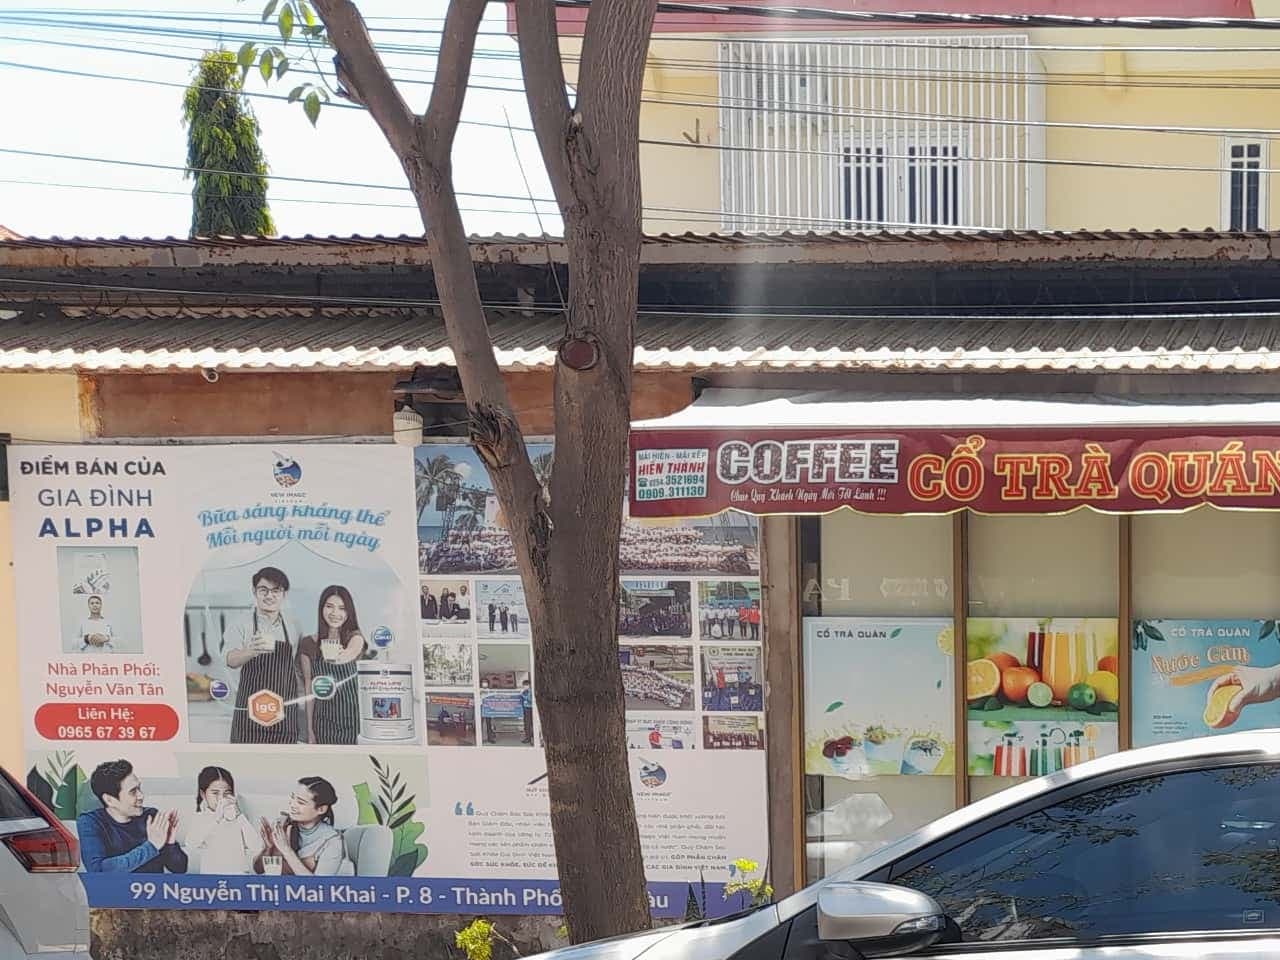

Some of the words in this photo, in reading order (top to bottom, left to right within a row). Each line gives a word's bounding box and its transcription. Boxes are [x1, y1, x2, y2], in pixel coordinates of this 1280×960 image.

[20, 455, 69, 475] ĐIỂM
[76, 457, 118, 475] BÁN
[124, 456, 166, 475] CỦA
[716, 439, 899, 485] COFFEE
[907, 434, 985, 501] CỔ
[994, 443, 1119, 500] TRÀ
[38, 489, 82, 507] GIA
[90, 484, 152, 507] ĐÌNH
[39, 518, 155, 537] ALPHA
[207, 527, 240, 549] Mỗi
[297, 522, 330, 541] mỗi
[333, 531, 380, 552] ngày
[1207, 646, 1249, 663] Cam
[48, 662, 77, 676] Nhà
[82, 662, 118, 676] Phân
[124, 661, 161, 677] Phối:
[46, 680, 102, 697] Nguyễn
[106, 682, 134, 696] Văn
[138, 682, 164, 696] Tân
[78, 708, 106, 720] Liên
[111, 708, 134, 723] Hệ:
[256, 702, 276, 715] IgG
[58, 726, 92, 738] 0965
[96, 726, 113, 738] 67
[118, 726, 135, 738] 39
[139, 726, 156, 738] 67
[130, 882, 156, 900] 99
[163, 881, 242, 902] Nguyễn
[247, 884, 279, 905] Thị
[286, 885, 323, 902] Mai
[331, 885, 375, 903] Khai
[396, 887, 413, 904] P.
[420, 887, 432, 904] 8
[452, 887, 516, 906] Thành
[649, 892, 668, 908] àu
